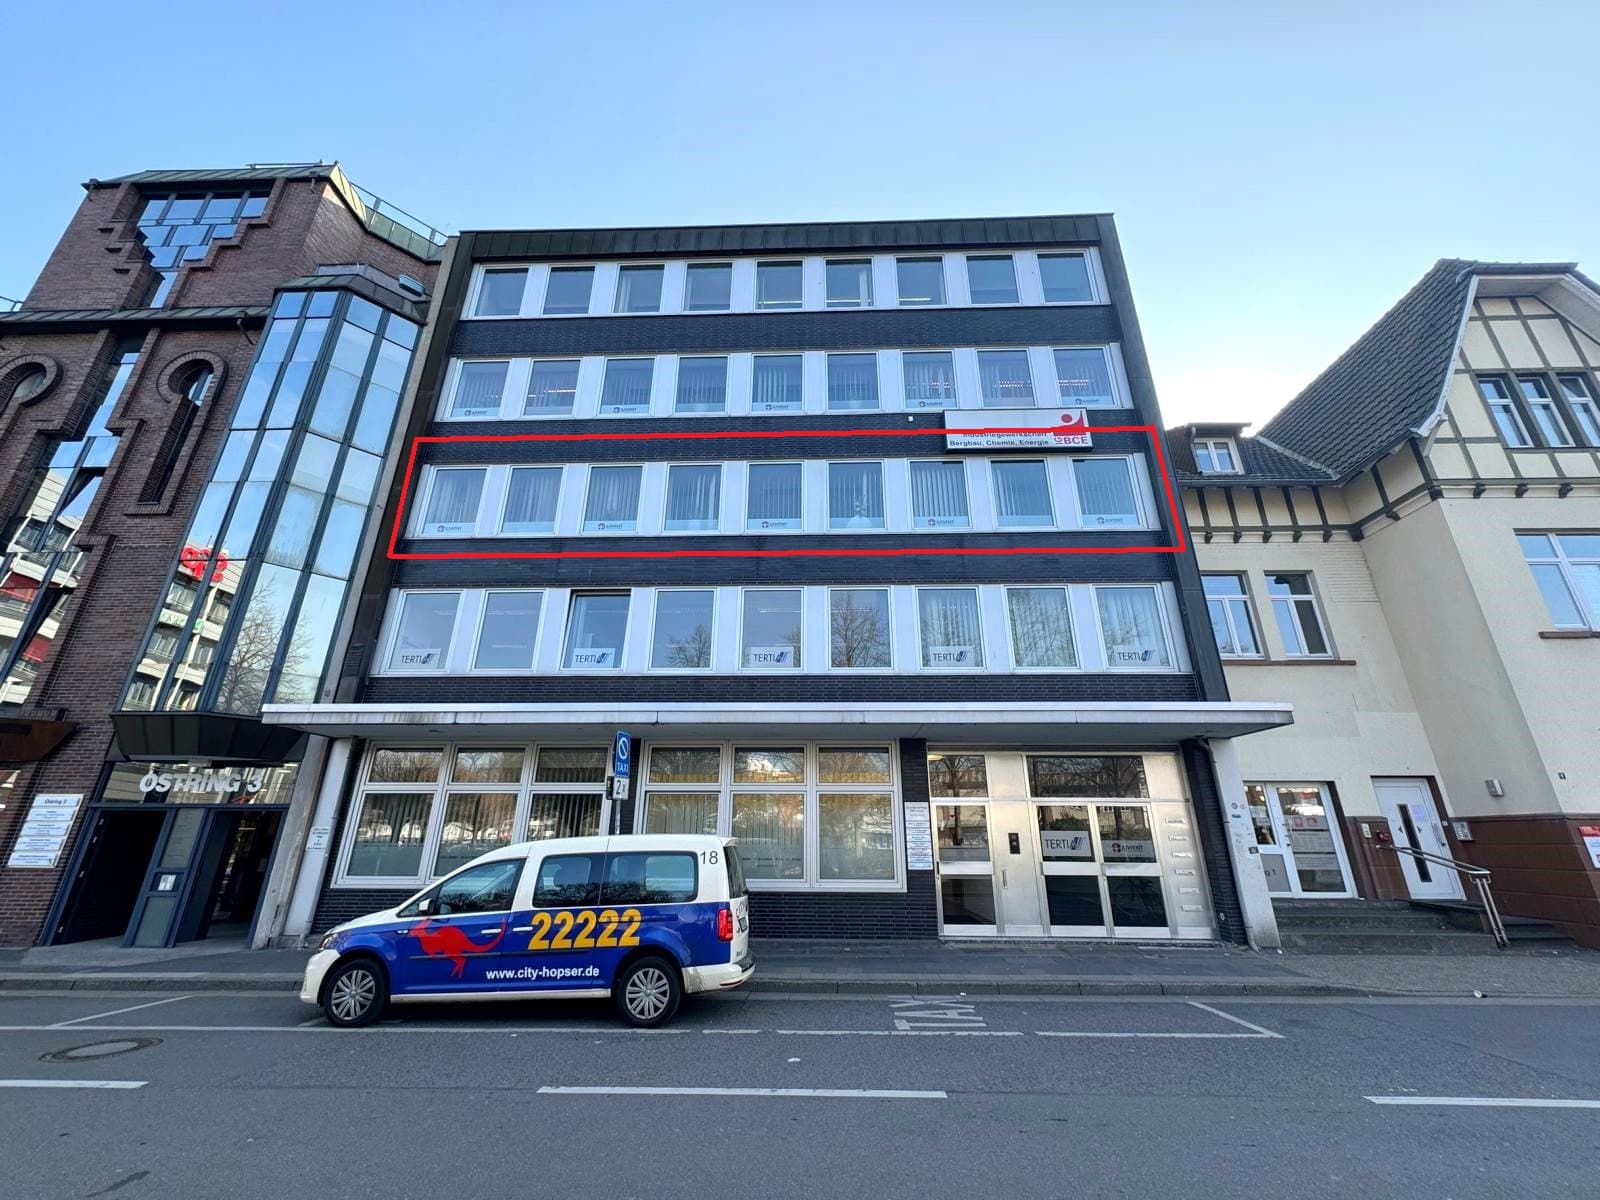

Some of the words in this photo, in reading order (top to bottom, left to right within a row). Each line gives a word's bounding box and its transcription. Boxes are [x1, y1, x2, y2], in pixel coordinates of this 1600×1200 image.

[1019, 439, 1049, 447] Energie
[1063, 437, 1089, 445] BCE
[617, 762, 629, 773] TAXI
[139, 773, 241, 793] OSTRING
[247, 774, 262, 793] 3
[700, 850, 719, 865] 18
[528, 908, 641, 950] 22222
[485, 965, 600, 981] www.city-hopser.de
